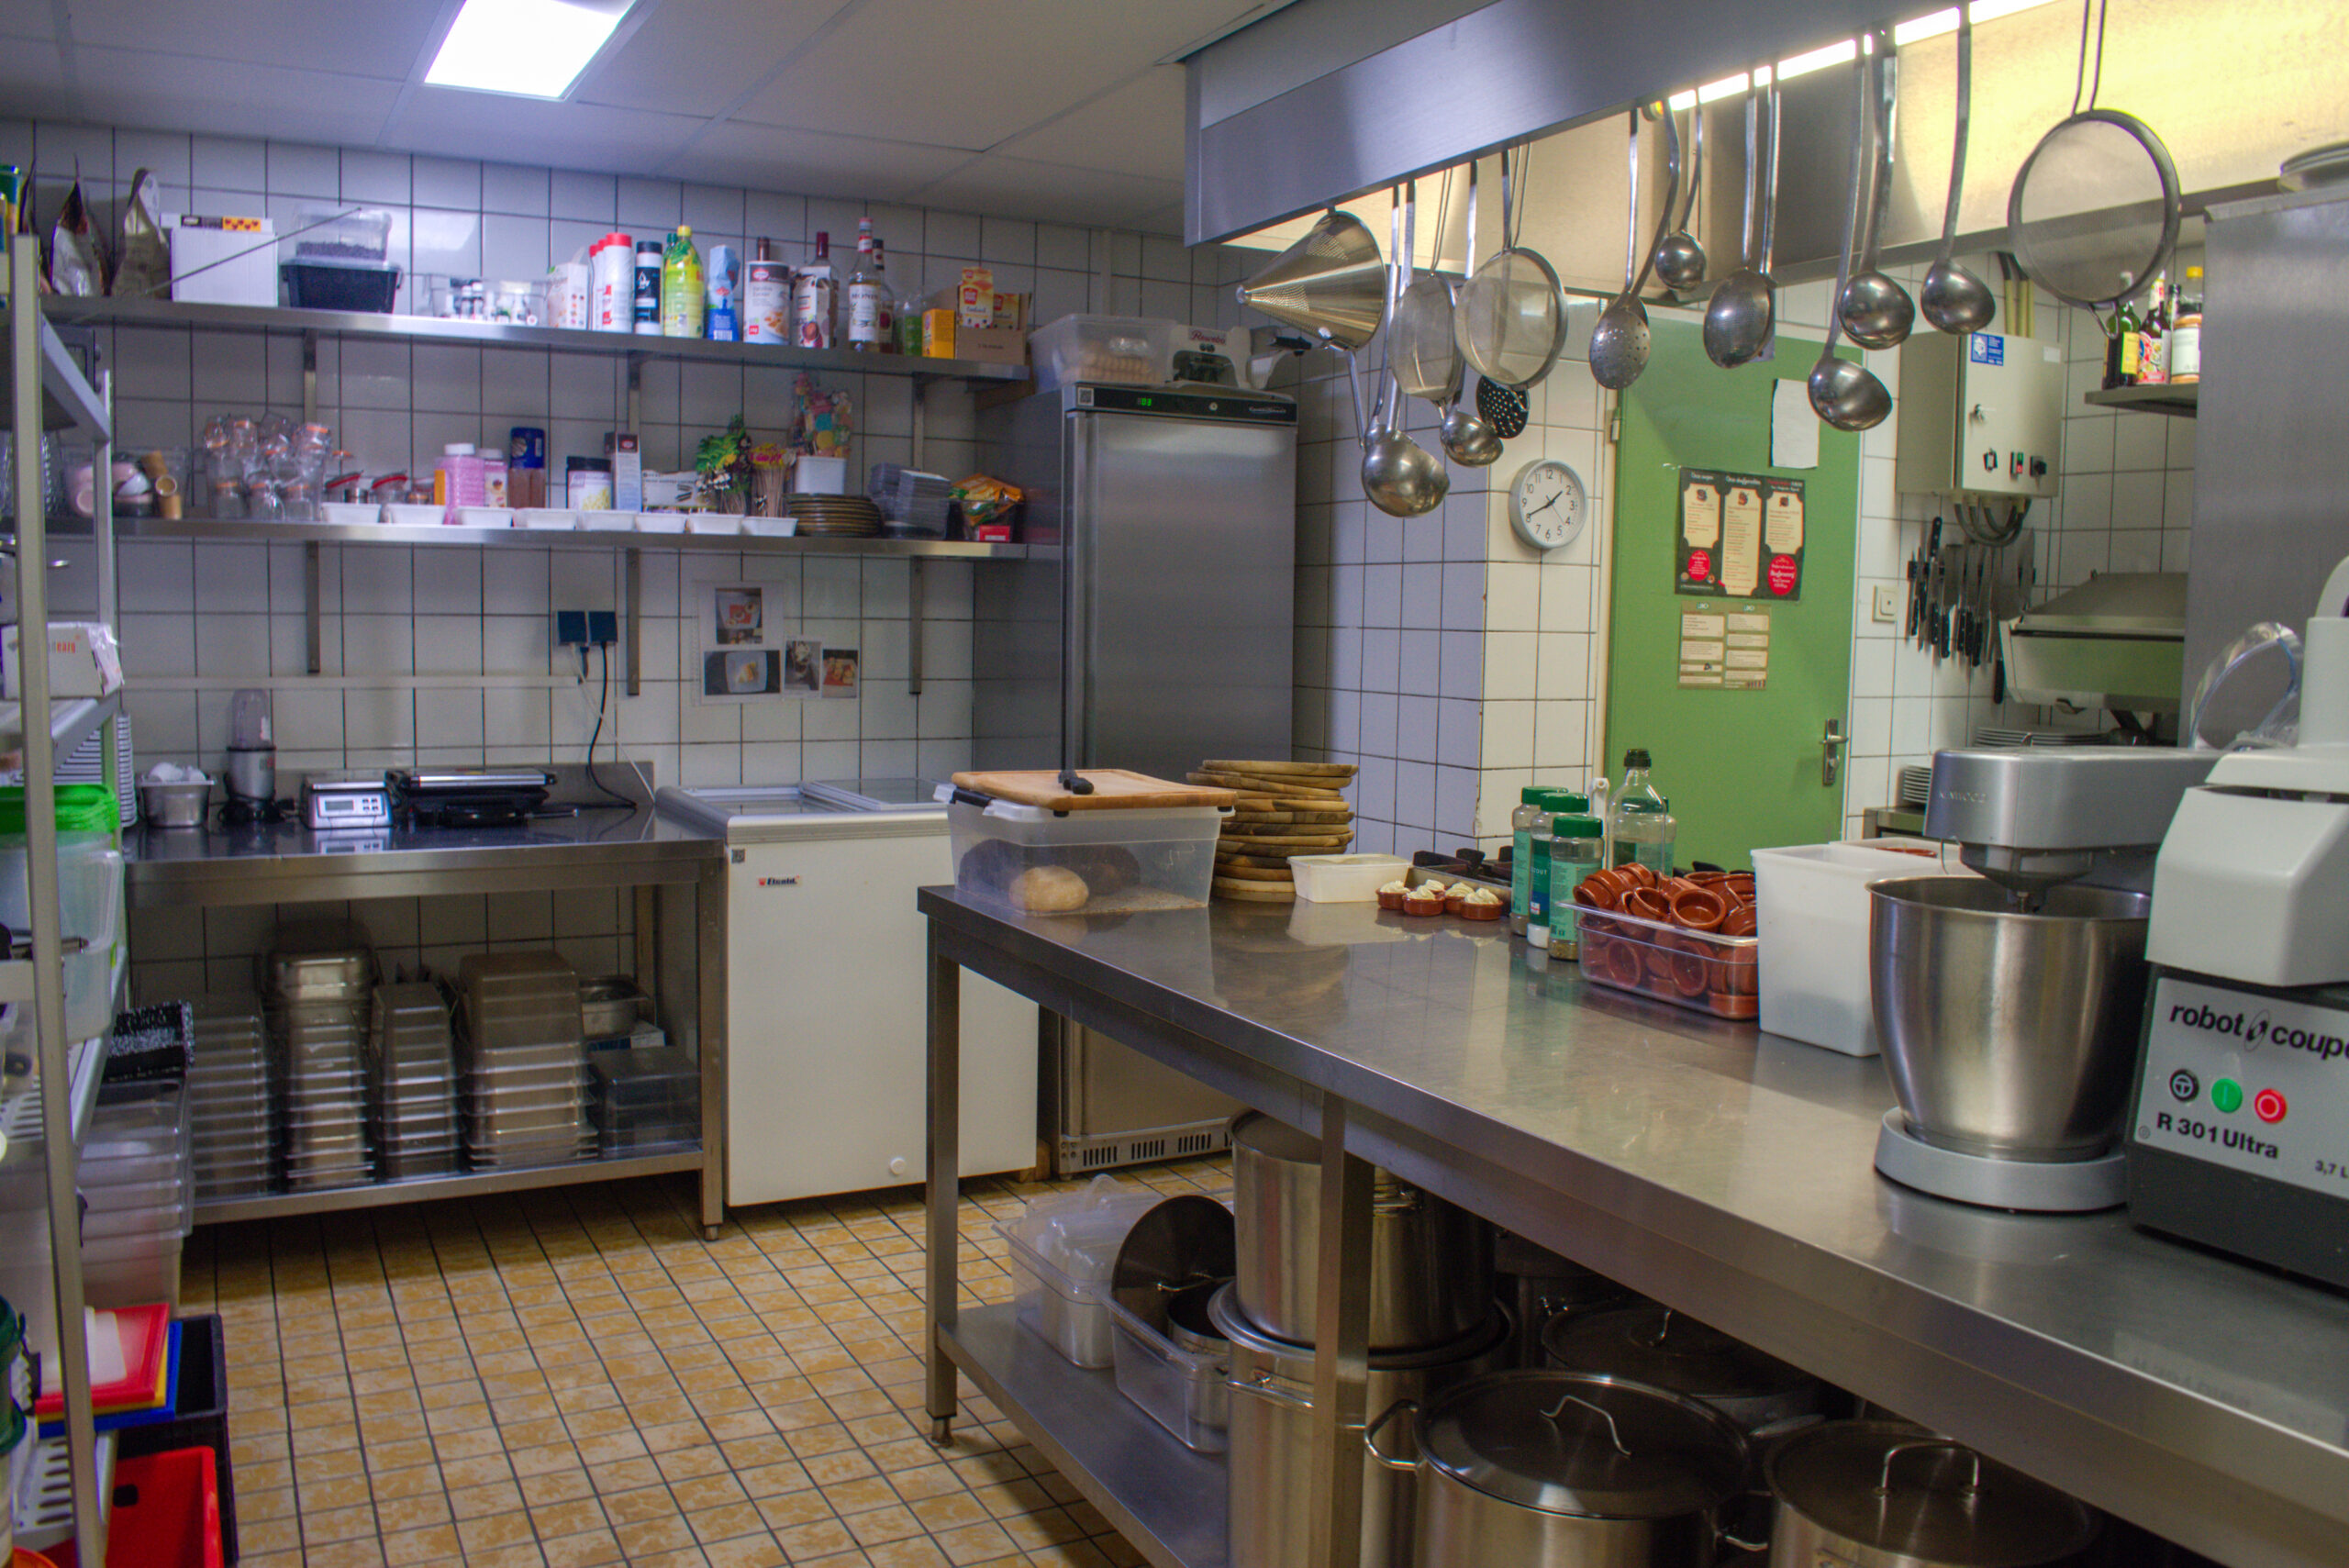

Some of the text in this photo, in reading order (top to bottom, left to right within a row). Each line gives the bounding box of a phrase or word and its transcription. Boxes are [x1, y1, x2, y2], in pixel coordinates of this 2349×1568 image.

[2170, 1003, 2243, 1037] robot
[2156, 1112, 2279, 1160] R 301 Ultra
[2314, 1160, 2337, 1177] 3,7
